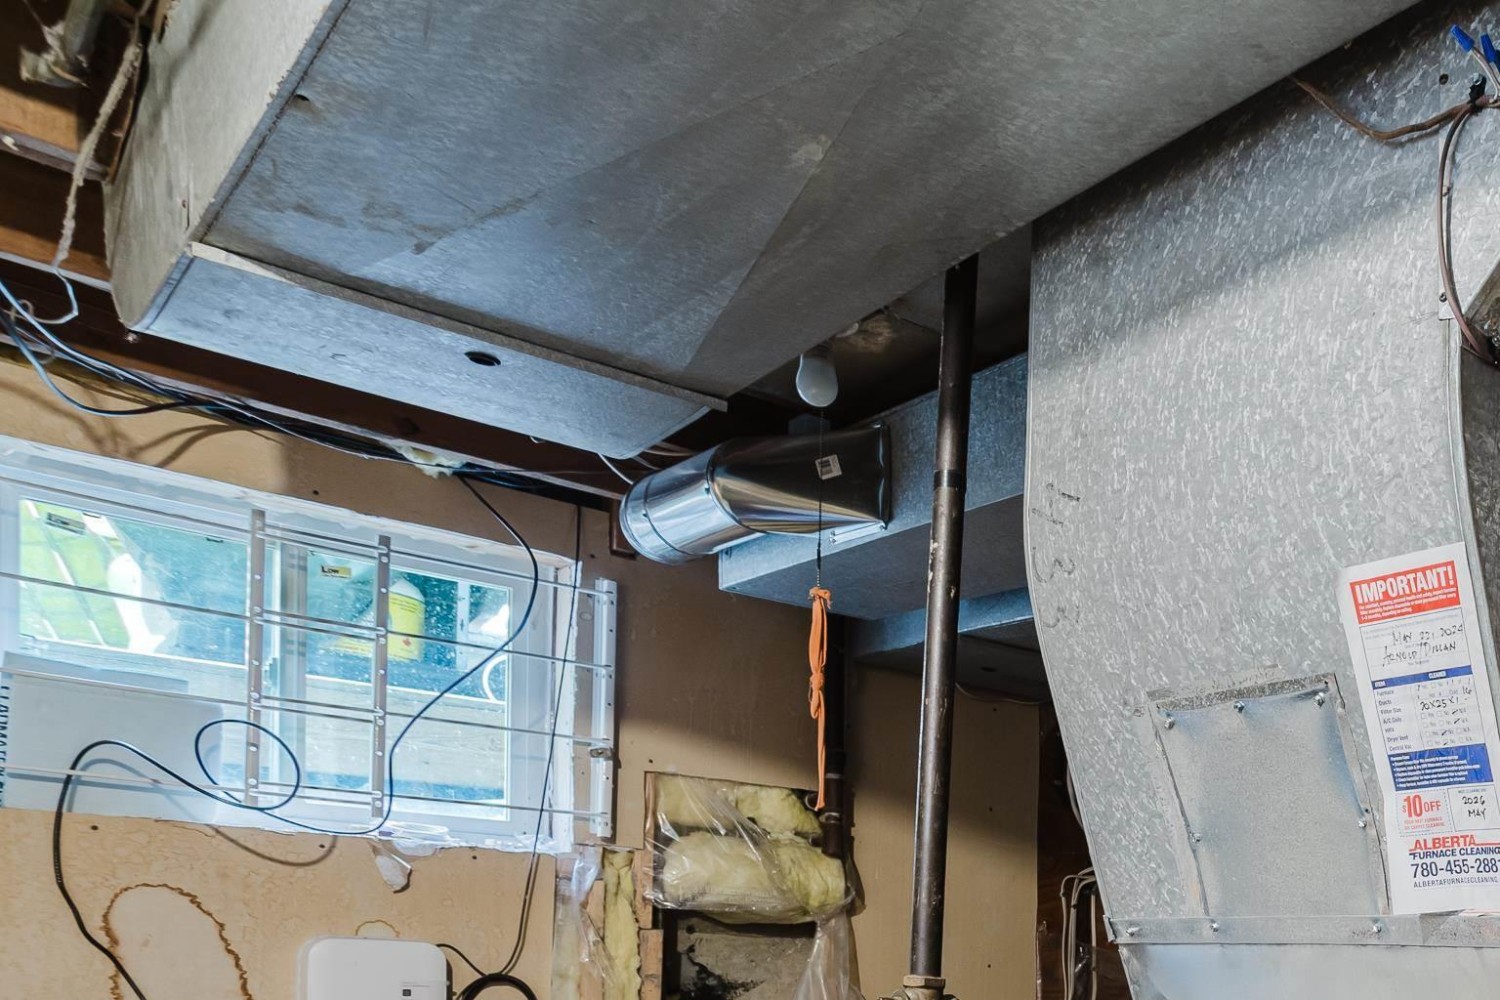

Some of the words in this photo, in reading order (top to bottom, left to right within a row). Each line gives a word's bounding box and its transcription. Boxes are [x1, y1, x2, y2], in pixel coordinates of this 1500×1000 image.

[1355, 565, 1455, 604] IMPORTANT!
[1402, 795, 1423, 818] $10
[1423, 800, 1442, 813] OFF
[1467, 808, 1487, 821] MAY
[1412, 834, 1477, 851] ALBERTA
[1410, 848, 1457, 860] FURNACE
